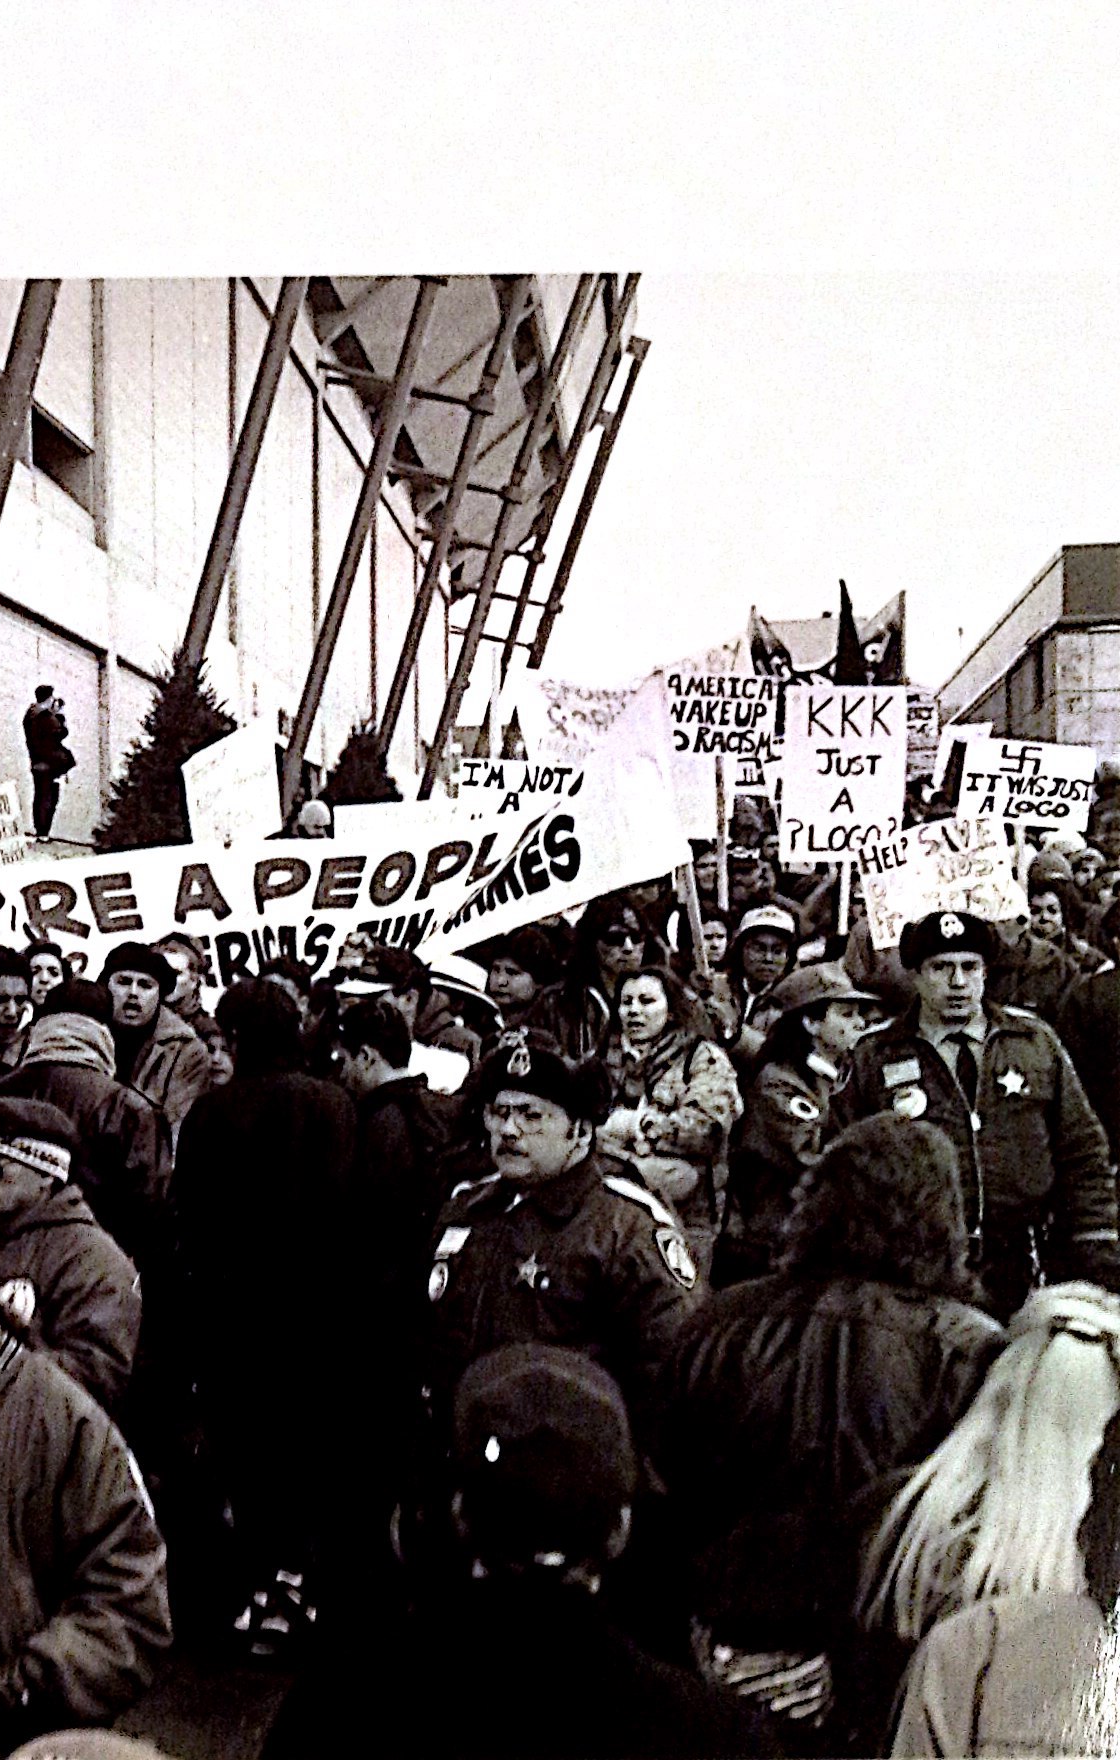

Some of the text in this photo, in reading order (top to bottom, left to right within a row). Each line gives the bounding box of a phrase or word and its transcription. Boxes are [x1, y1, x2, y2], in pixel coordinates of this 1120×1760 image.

[667, 673, 773, 701] AMERICA
[808, 694, 894, 738] KKK
[462, 761, 505, 790] I'M
[815, 748, 883, 777] JUST
[966, 772, 1002, 793] IT
[1007, 774, 1048, 796] WAS
[497, 792, 520, 814] A
[829, 787, 855, 814] A
[979, 795, 1071, 819] A LOGO
[174, 862, 232, 924] A
[253, 832, 503, 915] PEOPL
